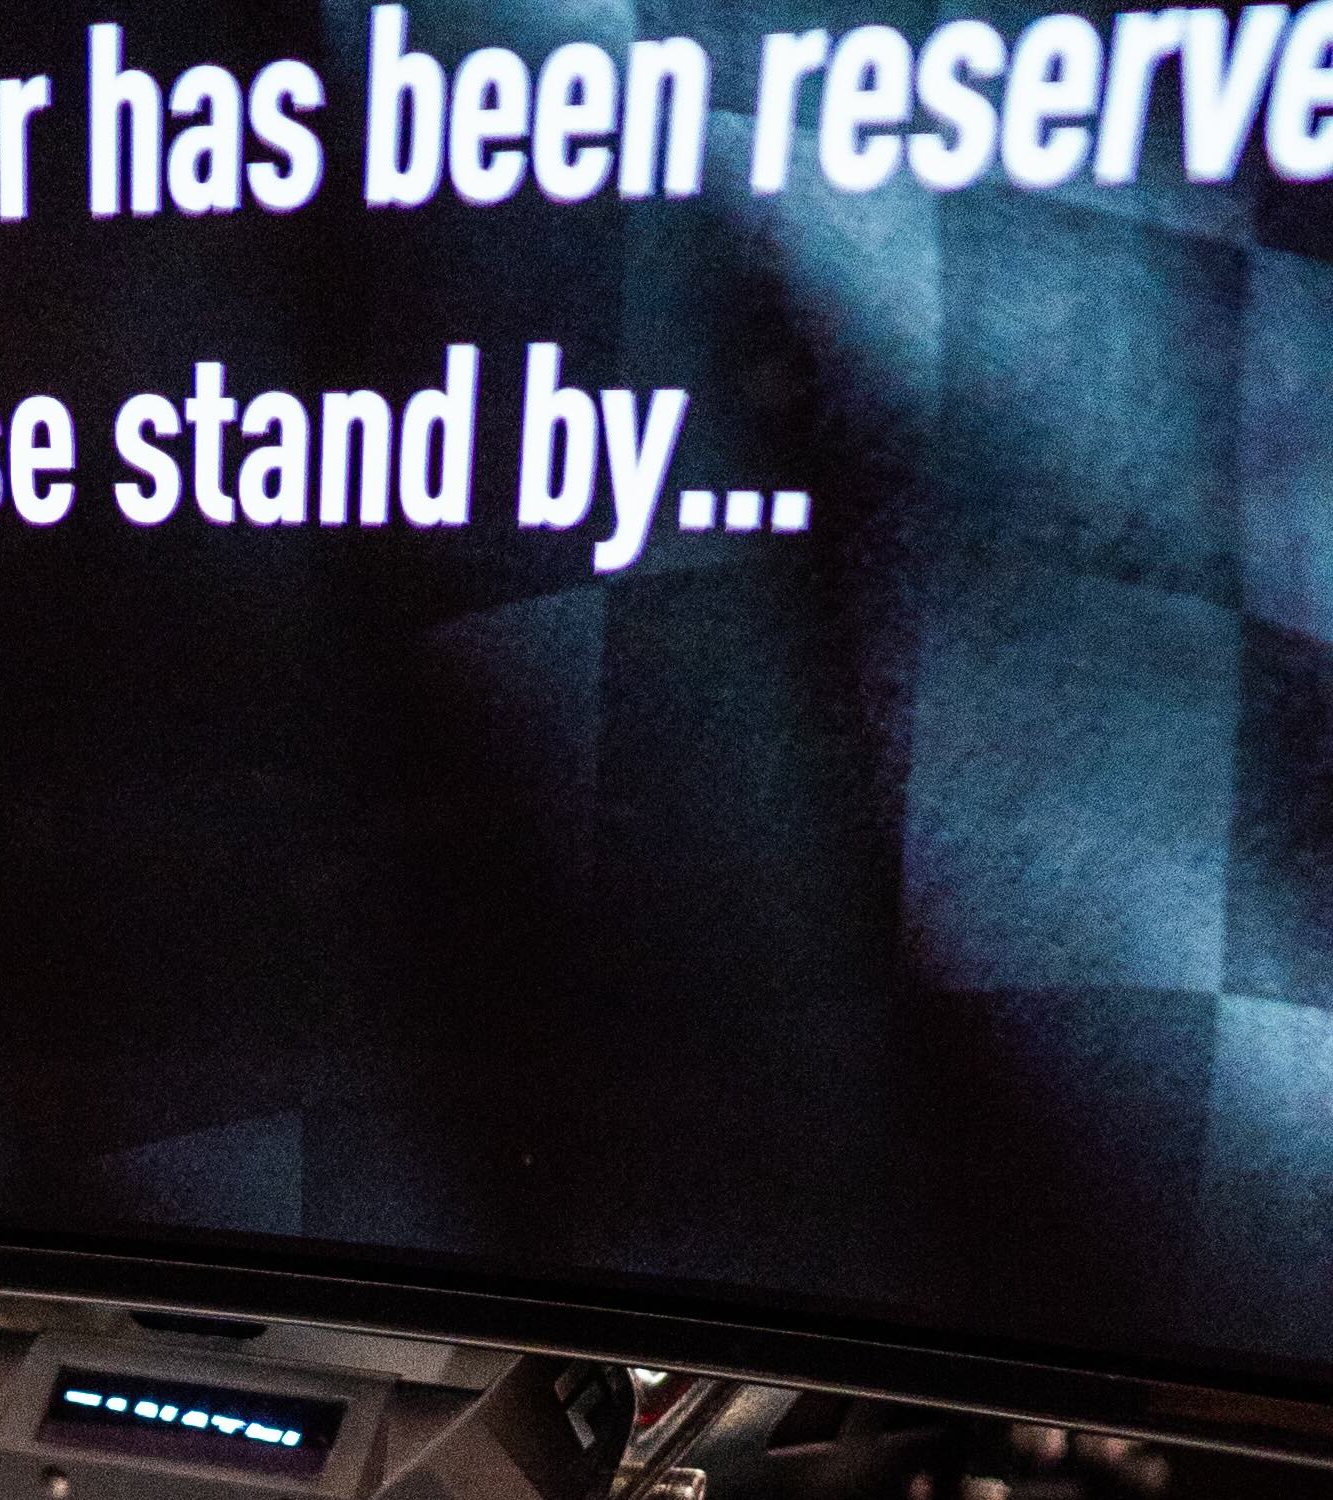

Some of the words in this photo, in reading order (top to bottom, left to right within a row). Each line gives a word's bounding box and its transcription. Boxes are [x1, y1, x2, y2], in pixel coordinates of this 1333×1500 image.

[90, 23, 321, 216] has
[366, 4, 707, 206] been
[113, 343, 477, 526] stand
[517, 341, 807, 571] by...
